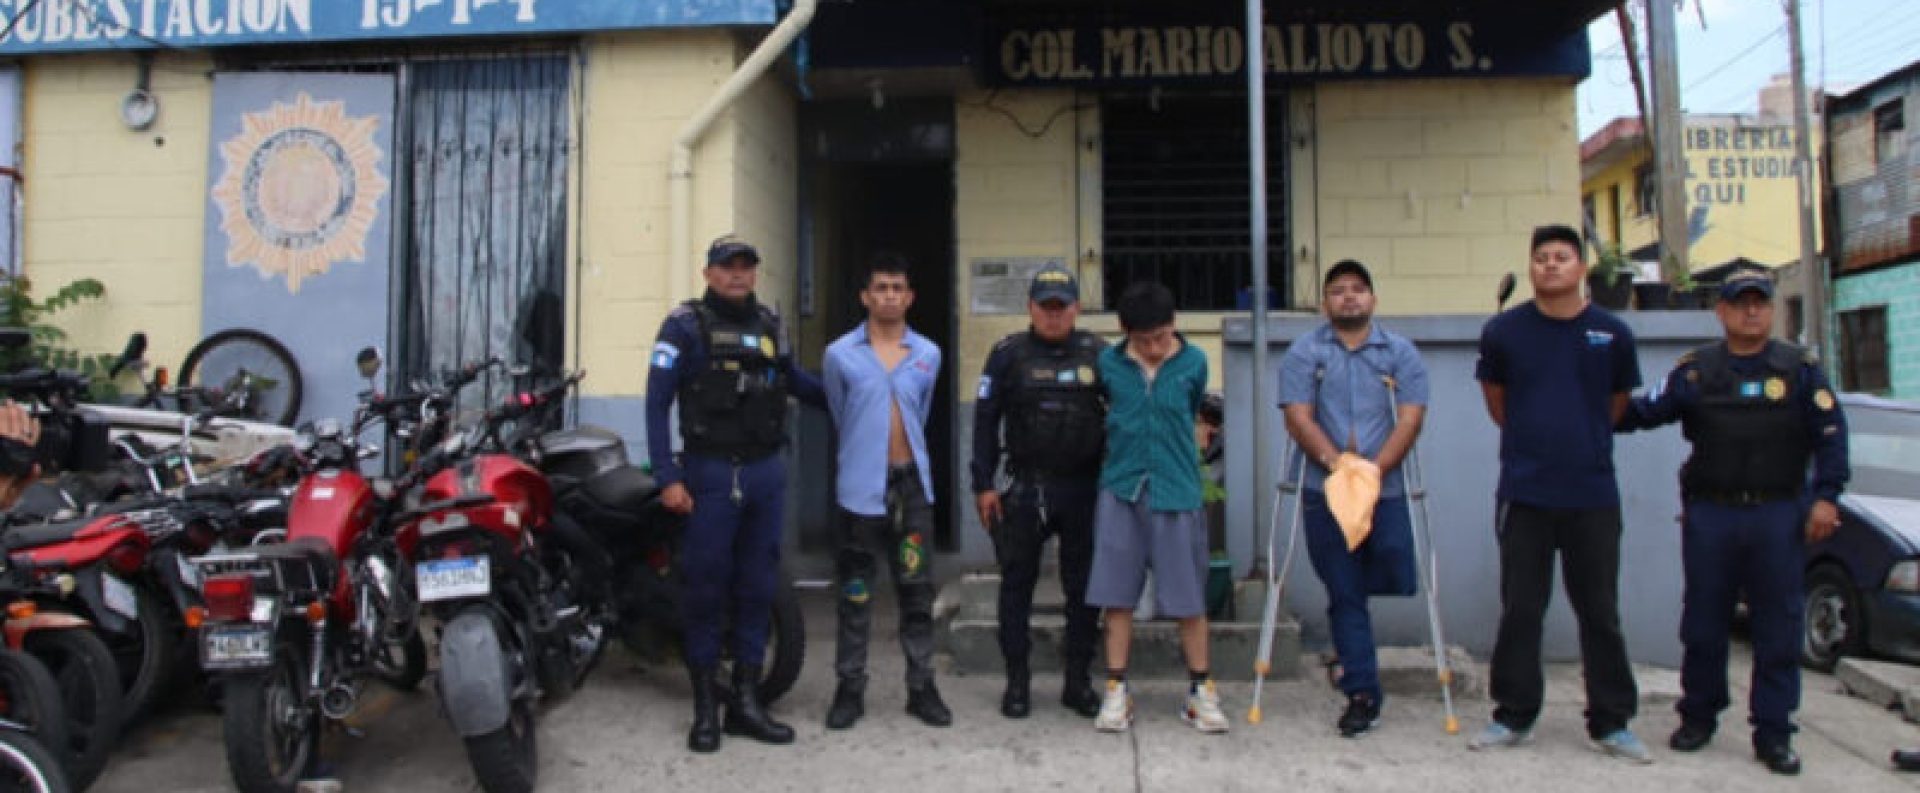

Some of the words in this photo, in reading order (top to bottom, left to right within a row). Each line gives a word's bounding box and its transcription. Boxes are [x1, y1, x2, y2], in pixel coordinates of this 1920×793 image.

[1102, 25, 1242, 77] MARIO
[1262, 22, 1425, 73] ALIOTO
[1446, 21, 1493, 71] S.
[1686, 127, 1794, 150] IBRERIA
[1708, 155, 1803, 178] ESTUDIA
[1684, 183, 1745, 204] QUI
